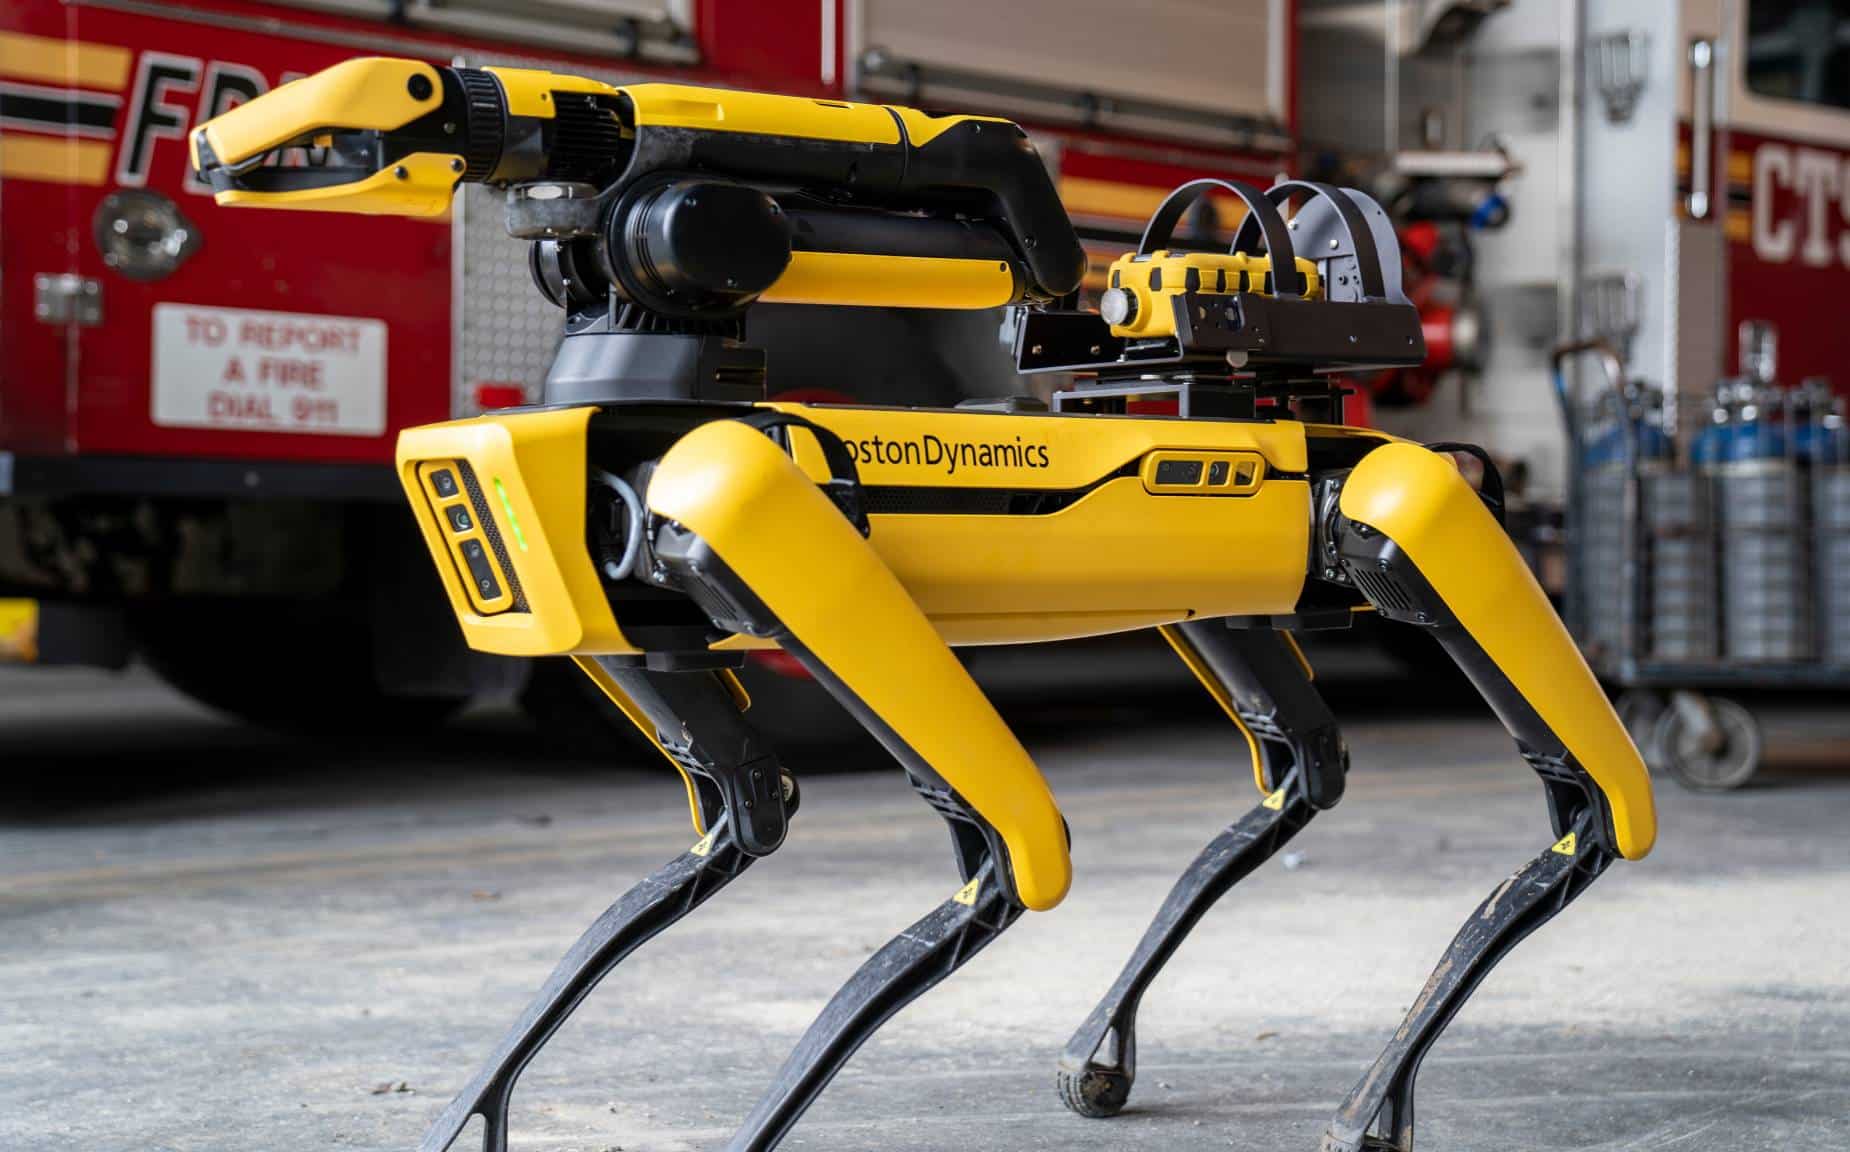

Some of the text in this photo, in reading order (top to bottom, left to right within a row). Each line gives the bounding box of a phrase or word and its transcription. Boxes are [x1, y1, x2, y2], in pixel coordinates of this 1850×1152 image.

[1754, 143, 1850, 268] CT
[185, 315, 361, 355] TO REPORT
[222, 355, 324, 390] A FIRE
[208, 390, 339, 423] DIAL 911
[843, 434, 1050, 475] ostonDynamics
